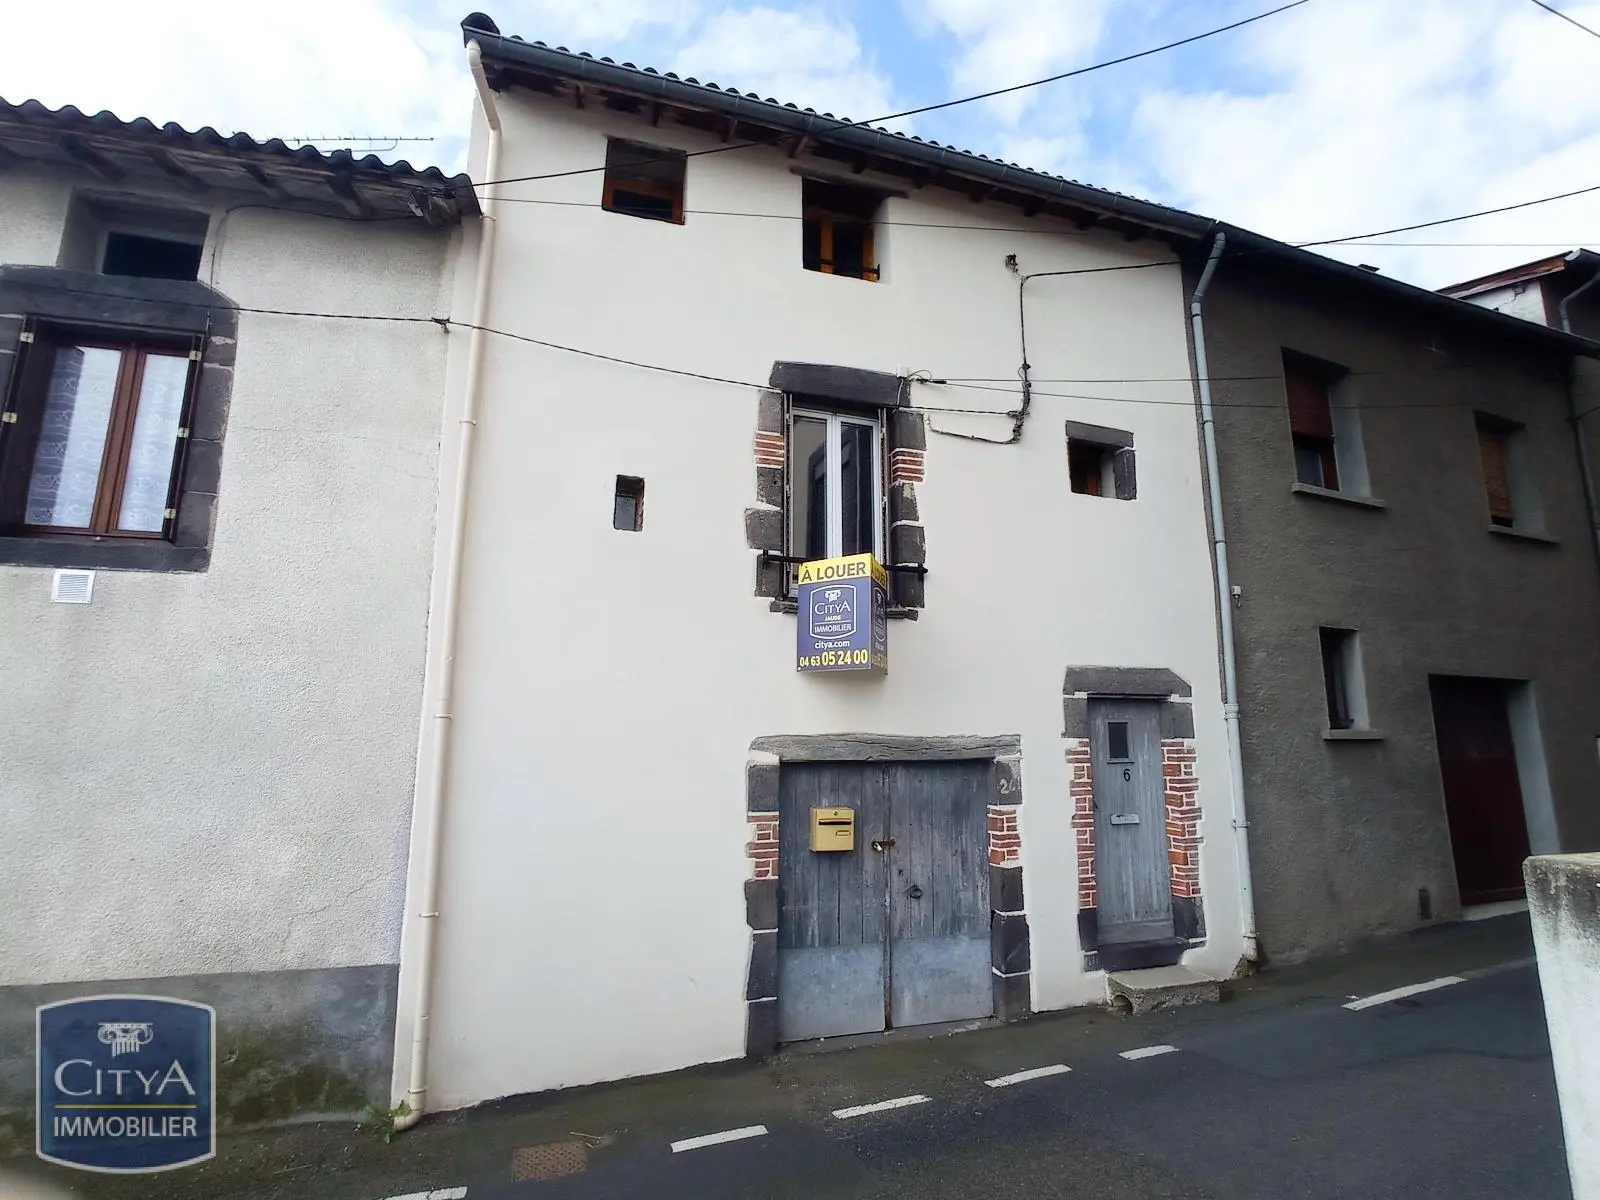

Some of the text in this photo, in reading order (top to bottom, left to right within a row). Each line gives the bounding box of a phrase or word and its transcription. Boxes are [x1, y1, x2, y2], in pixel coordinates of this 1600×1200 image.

[801, 565, 812, 582] À
[817, 562, 866, 580] LOUER
[814, 623, 852, 633] IMMOBILIER
[815, 640, 850, 650] citya.com
[800, 657, 809, 667] 04
[811, 656, 820, 667] 63
[822, 651, 836, 666] 05
[837, 650, 851, 665] 24
[853, 649, 868, 664] 00
[1123, 768, 1131, 782] 6
